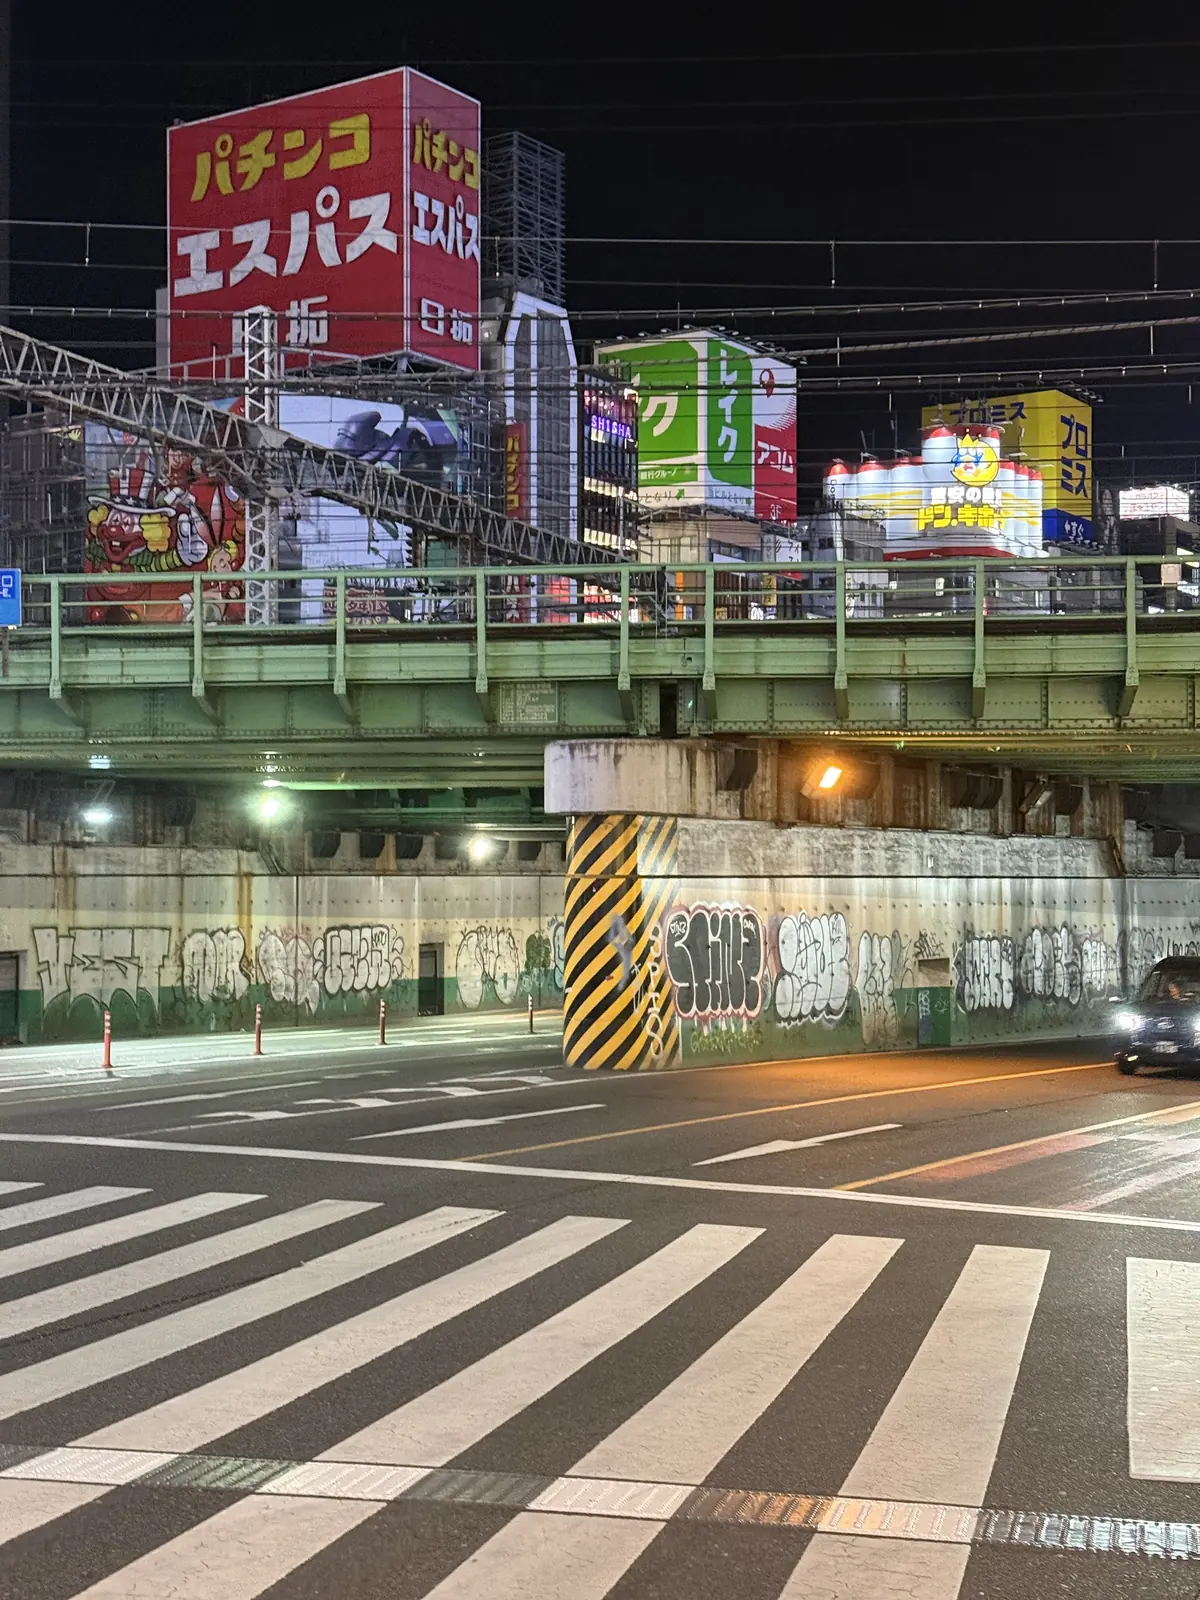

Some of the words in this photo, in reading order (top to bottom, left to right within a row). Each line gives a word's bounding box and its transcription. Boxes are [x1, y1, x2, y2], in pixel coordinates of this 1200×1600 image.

[191, 113, 371, 202] パチンコ
[413, 118, 479, 190] パチンコ
[174, 186, 398, 298] エスパス
[413, 190, 480, 264] エスパス
[591, 415, 632, 439] SHISHA
[718, 348, 739, 463] レイク
[950, 401, 1027, 424] プロミス
[507, 433, 520, 512] パチンコ
[757, 441, 794, 474] アコム
